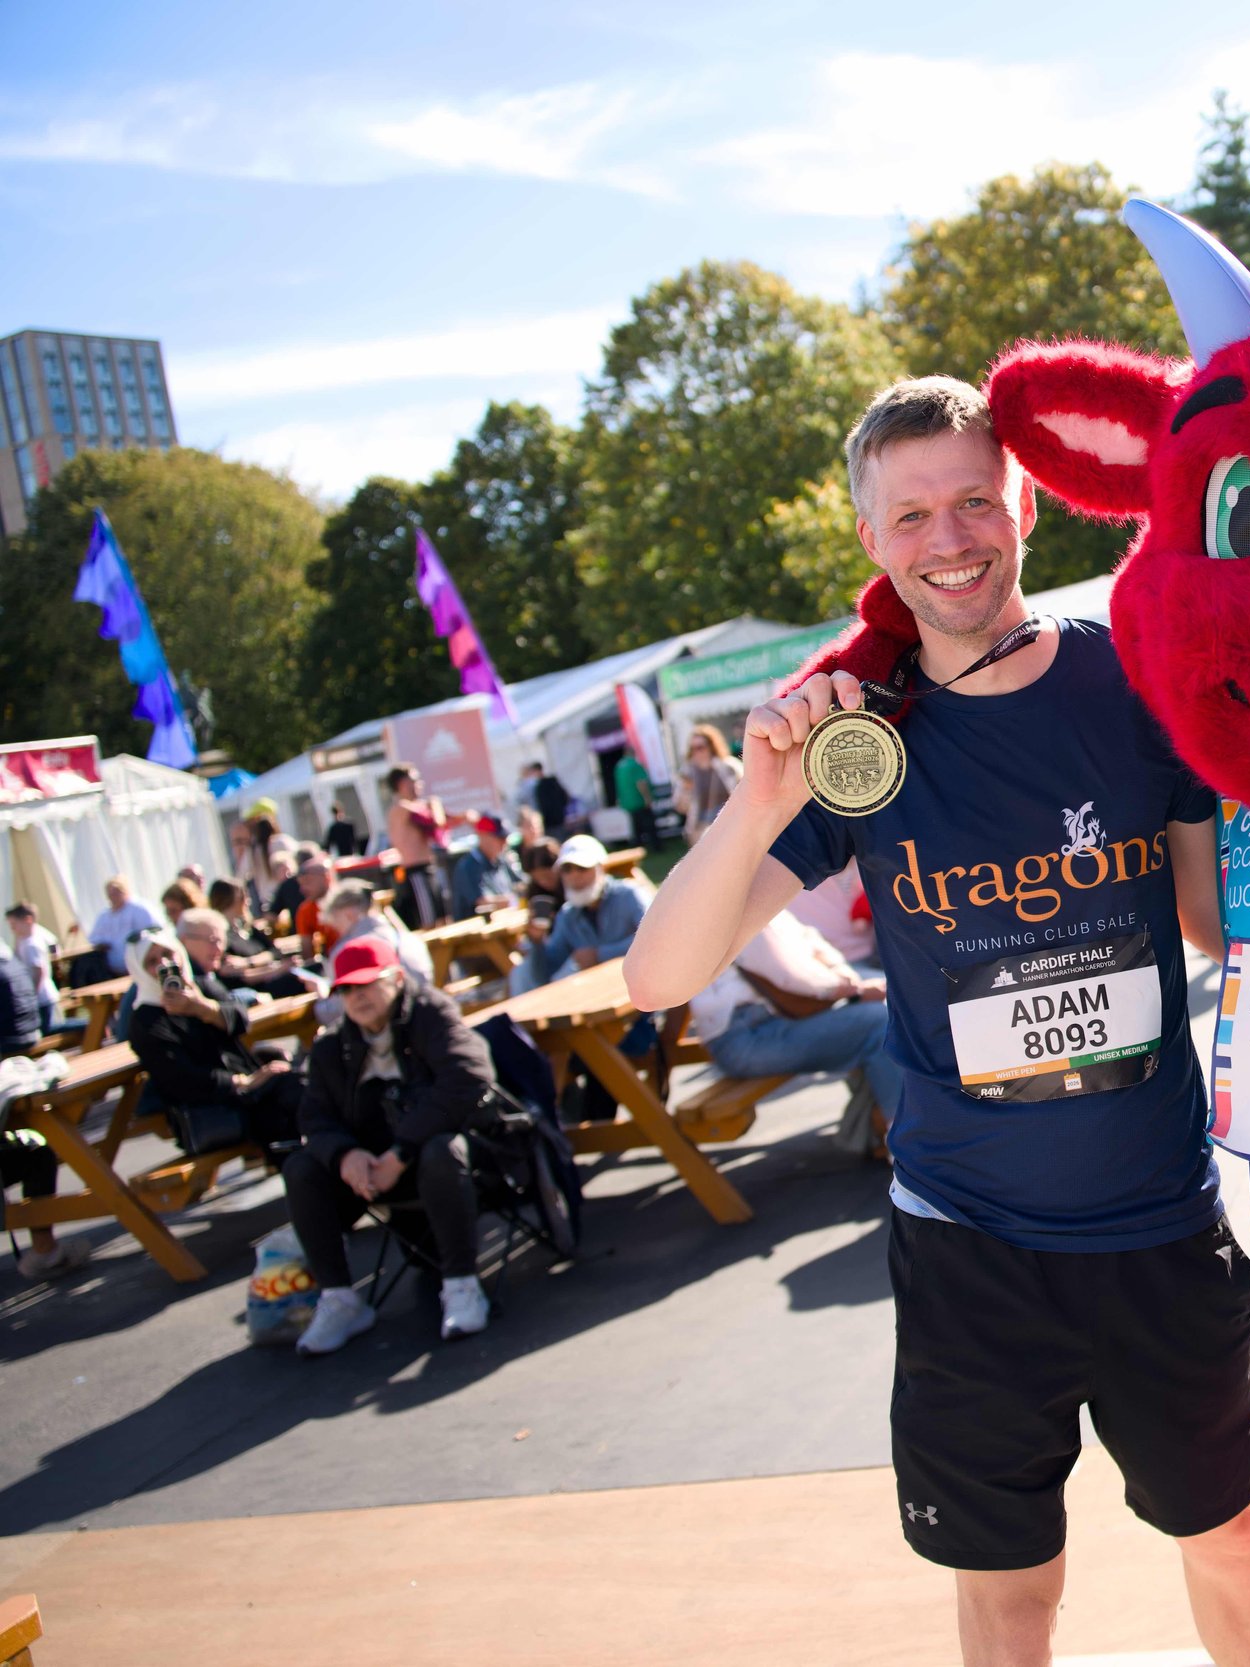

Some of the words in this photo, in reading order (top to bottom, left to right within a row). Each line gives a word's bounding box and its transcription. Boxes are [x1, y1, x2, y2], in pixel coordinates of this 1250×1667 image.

[994, 633, 1015, 657] CARDIFF
[1014, 624, 1031, 640] HALF
[860, 748, 879, 756] HALF
[893, 830, 1167, 934] dragons
[955, 932, 1036, 953] RUNNING
[1044, 921, 1091, 942] CLUB
[1096, 912, 1137, 932] SALE
[1020, 953, 1078, 974] CARDIFF
[1079, 946, 1114, 963] HALF
[1022, 972, 1049, 983] HANNER
[1049, 966, 1085, 978] MARATHON
[1084, 959, 1117, 971] CAERDYDD
[1011, 983, 1110, 1028] ADAM
[1023, 1019, 1108, 1059] 8093
[1093, 1051, 1121, 1062] UNISEX
[1121, 1044, 1149, 1056] MEDIUM
[995, 1069, 1020, 1080] WHITE
[1020, 1067, 1036, 1076] PEN
[981, 1086, 1005, 1097] R4W
